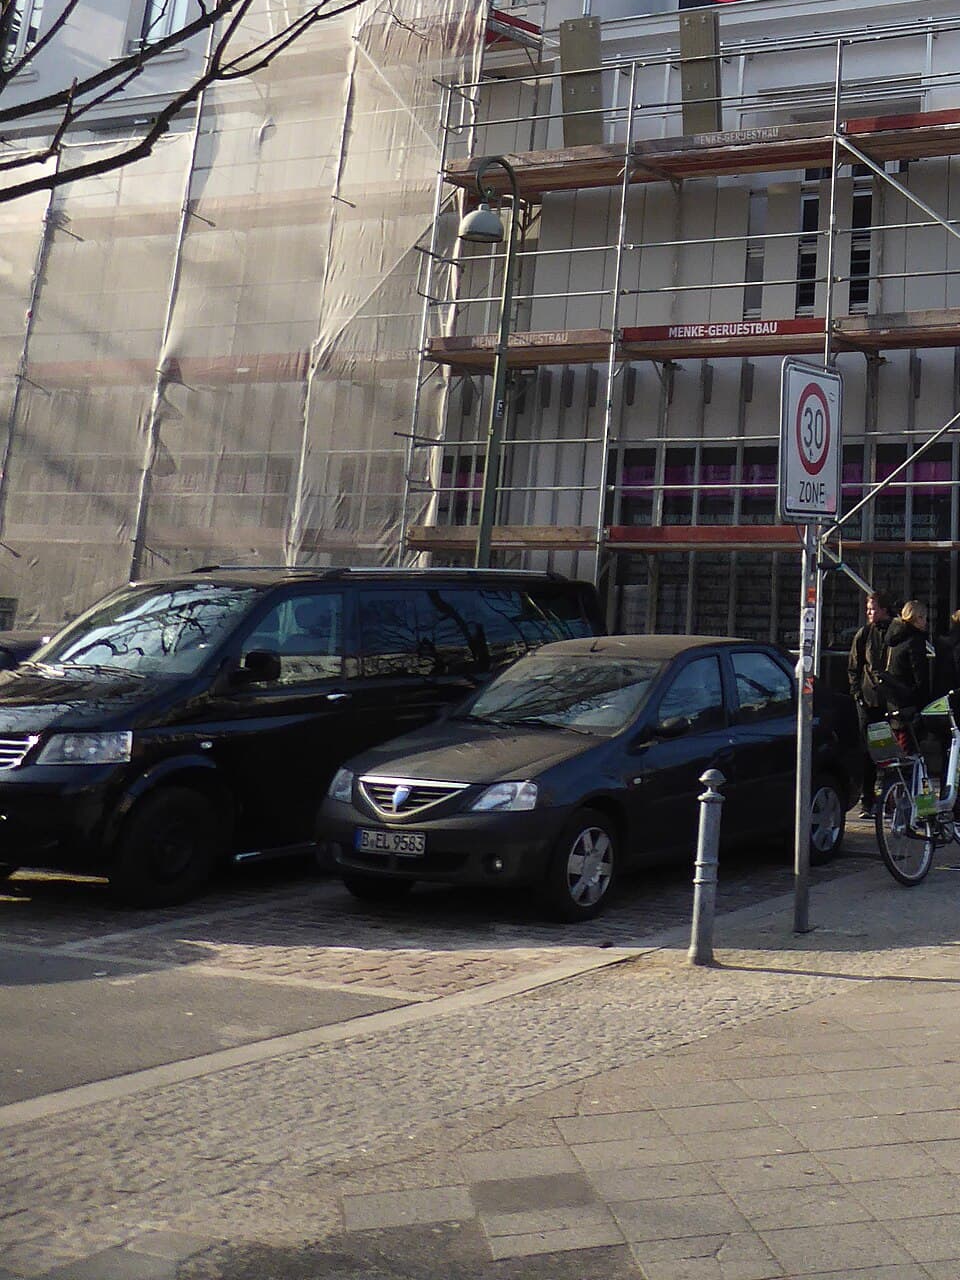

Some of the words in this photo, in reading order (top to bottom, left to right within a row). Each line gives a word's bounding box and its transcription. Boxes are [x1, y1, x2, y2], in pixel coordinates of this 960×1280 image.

[668, 322, 778, 338] MENKE-GERUESTBAU
[804, 407, 823, 449] 30
[799, 481, 825, 504] ZONE
[362, 832, 369, 847] B
[376, 834, 390, 849] EL
[394, 835, 424, 851] 9583
